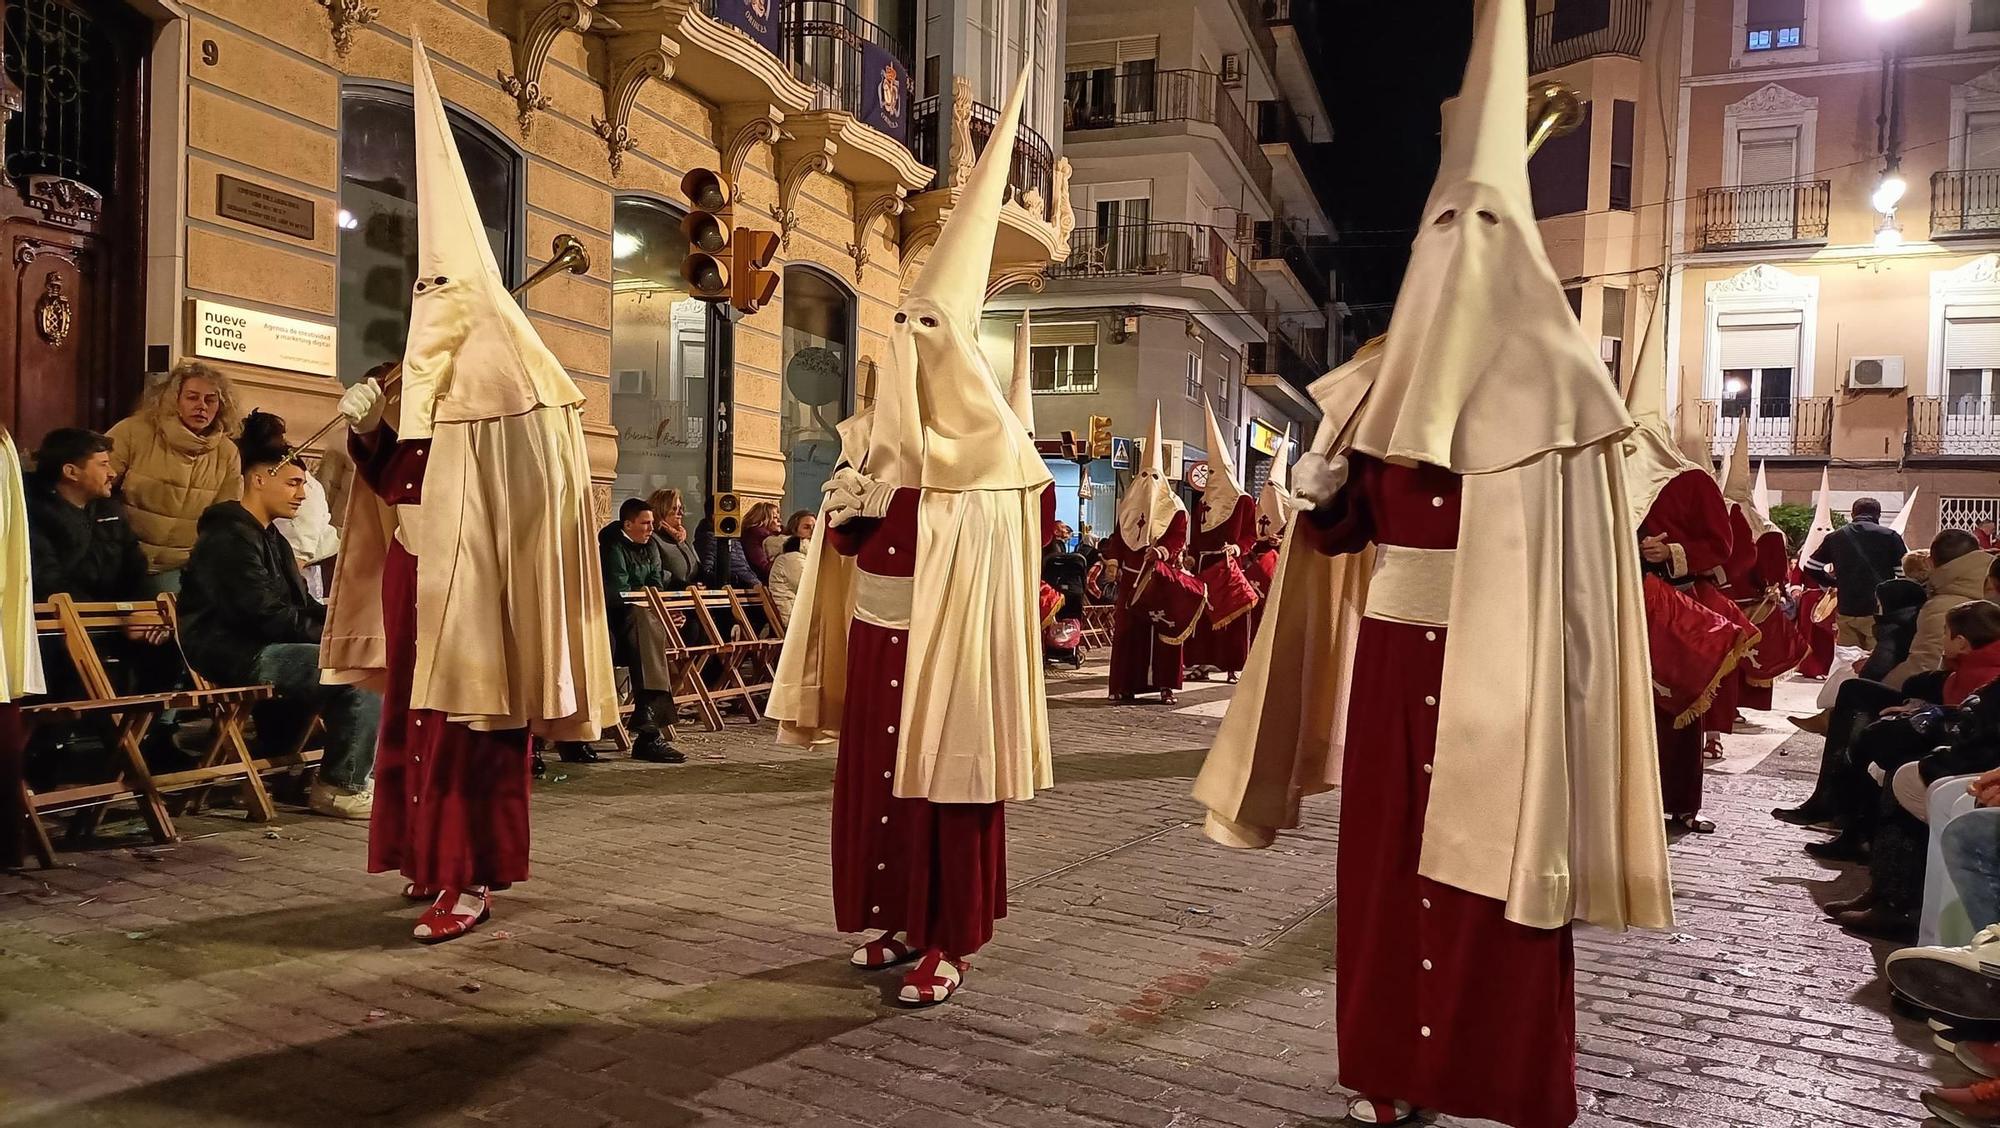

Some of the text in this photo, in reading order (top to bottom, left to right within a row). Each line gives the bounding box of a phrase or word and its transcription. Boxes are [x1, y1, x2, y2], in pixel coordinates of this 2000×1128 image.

[202, 39, 219, 67] 9
[205, 311, 247, 328] nueve
[204, 324, 243, 340] coma
[204, 337, 247, 353] nueve
